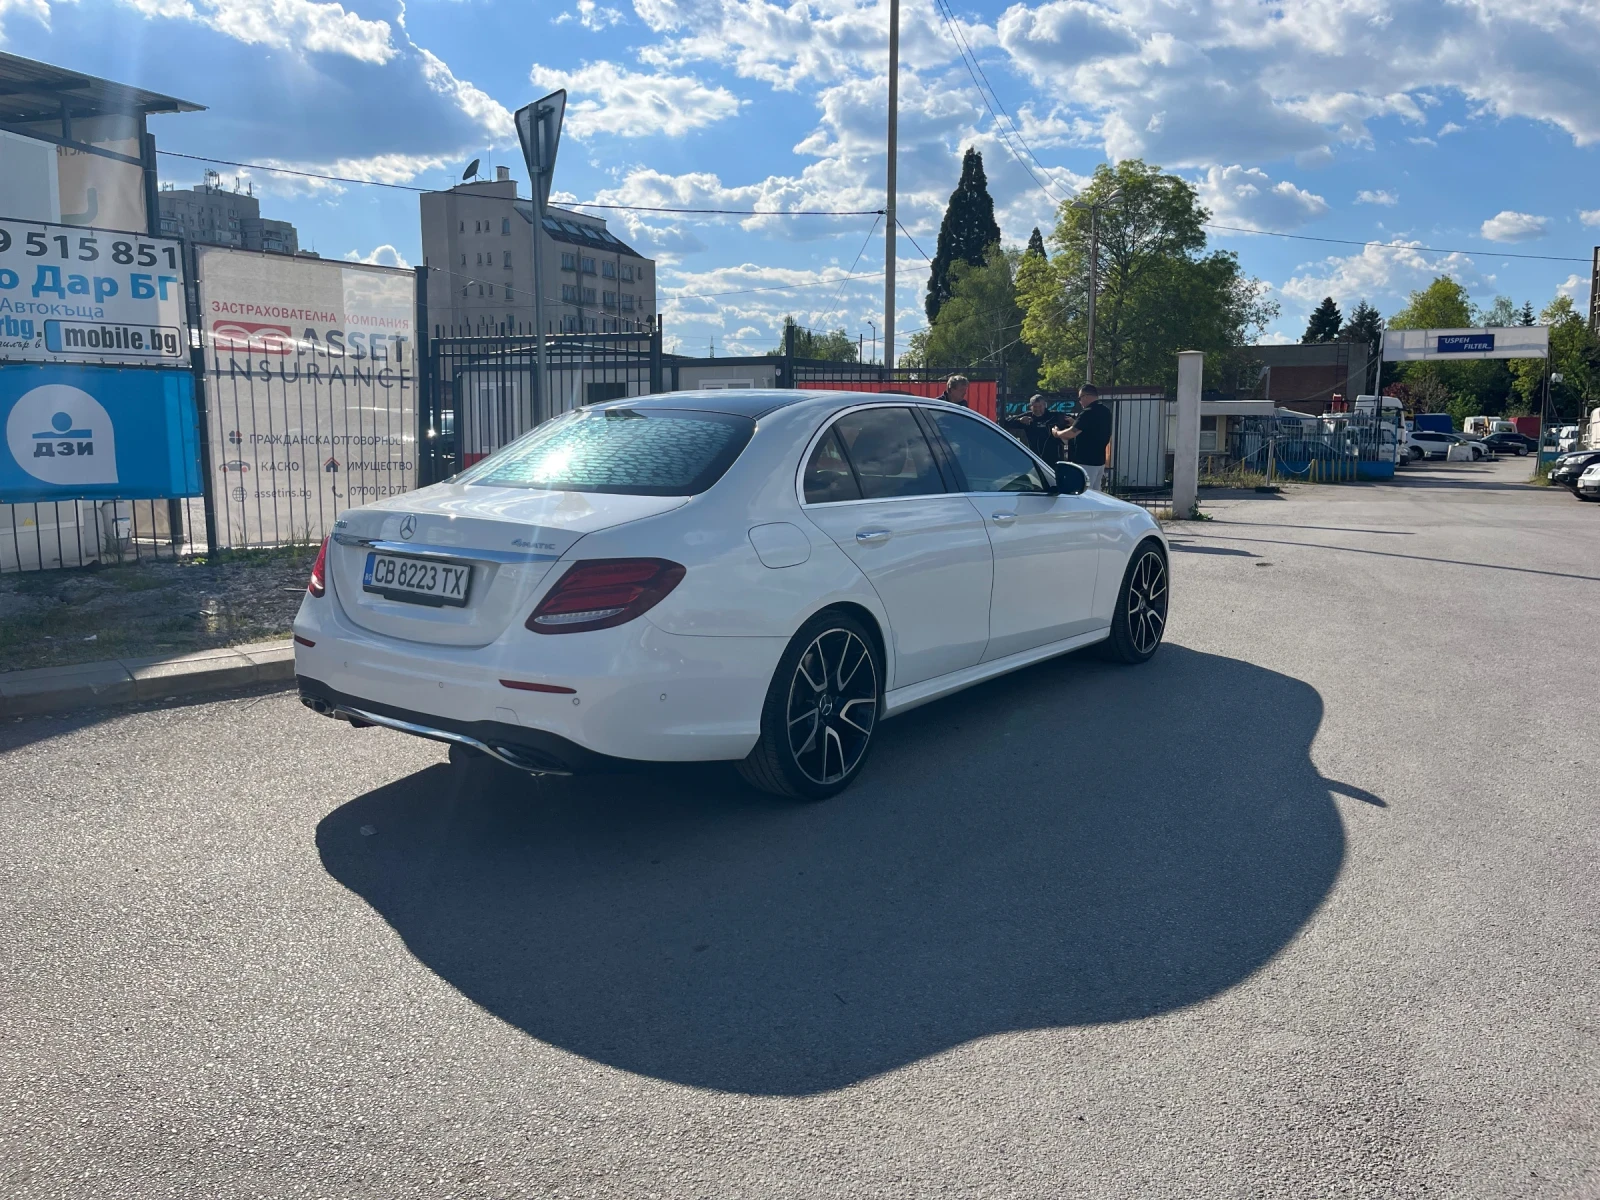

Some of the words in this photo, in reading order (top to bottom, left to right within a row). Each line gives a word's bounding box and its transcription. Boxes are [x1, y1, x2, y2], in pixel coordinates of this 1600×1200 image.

[26, 231, 99, 262] 515
[112, 241, 177, 270] 851
[32, 264, 119, 303] Дар
[130, 273, 178, 301] БГ
[0, 297, 104, 320] Автокъща
[211, 300, 337, 323] ЗАСТРАХОВАТЕЛНА
[343, 313, 409, 329] КОМПАНИЯ
[64, 326, 177, 354] mobile.bg
[299, 327, 409, 362] ASSET
[215, 357, 411, 390] INSURANCE
[33, 441, 94, 458] ДЗИ
[332, 435, 408, 446] ОТГОВОРНОС
[261, 461, 300, 472] КАСКО
[347, 461, 413, 473] ИМУЩЕСТВО
[254, 487, 312, 499] assetins.bg
[350, 486, 375, 496] 0700
[374, 559, 396, 584] CB
[398, 562, 437, 590] 8223
[442, 567, 465, 595] TX
